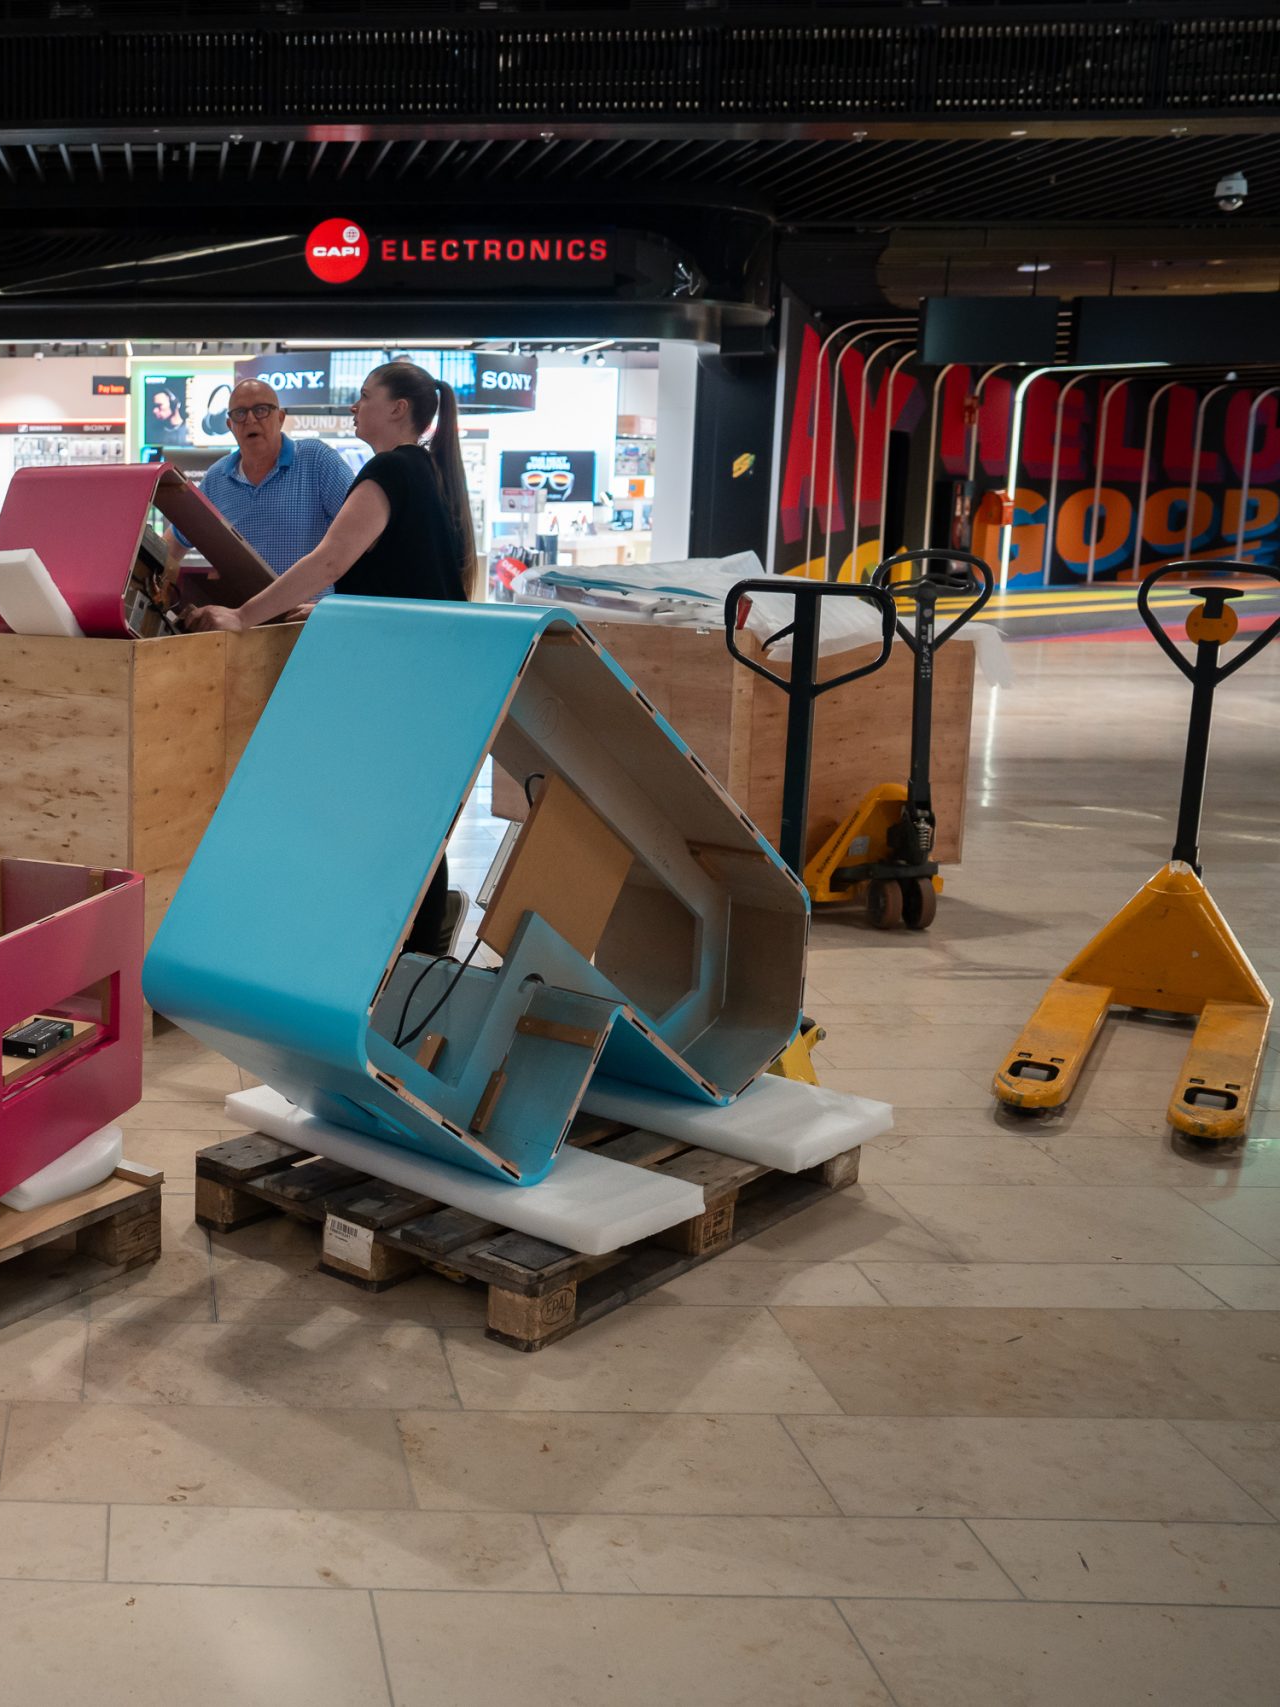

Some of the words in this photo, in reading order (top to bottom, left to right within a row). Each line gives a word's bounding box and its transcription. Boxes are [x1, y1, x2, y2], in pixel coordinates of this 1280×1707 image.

[313, 246, 360, 257] CAPI
[381, 239, 608, 261] ELECTRONICS
[482, 370, 532, 391] SONY
[294, 416, 337, 429] SOUND
